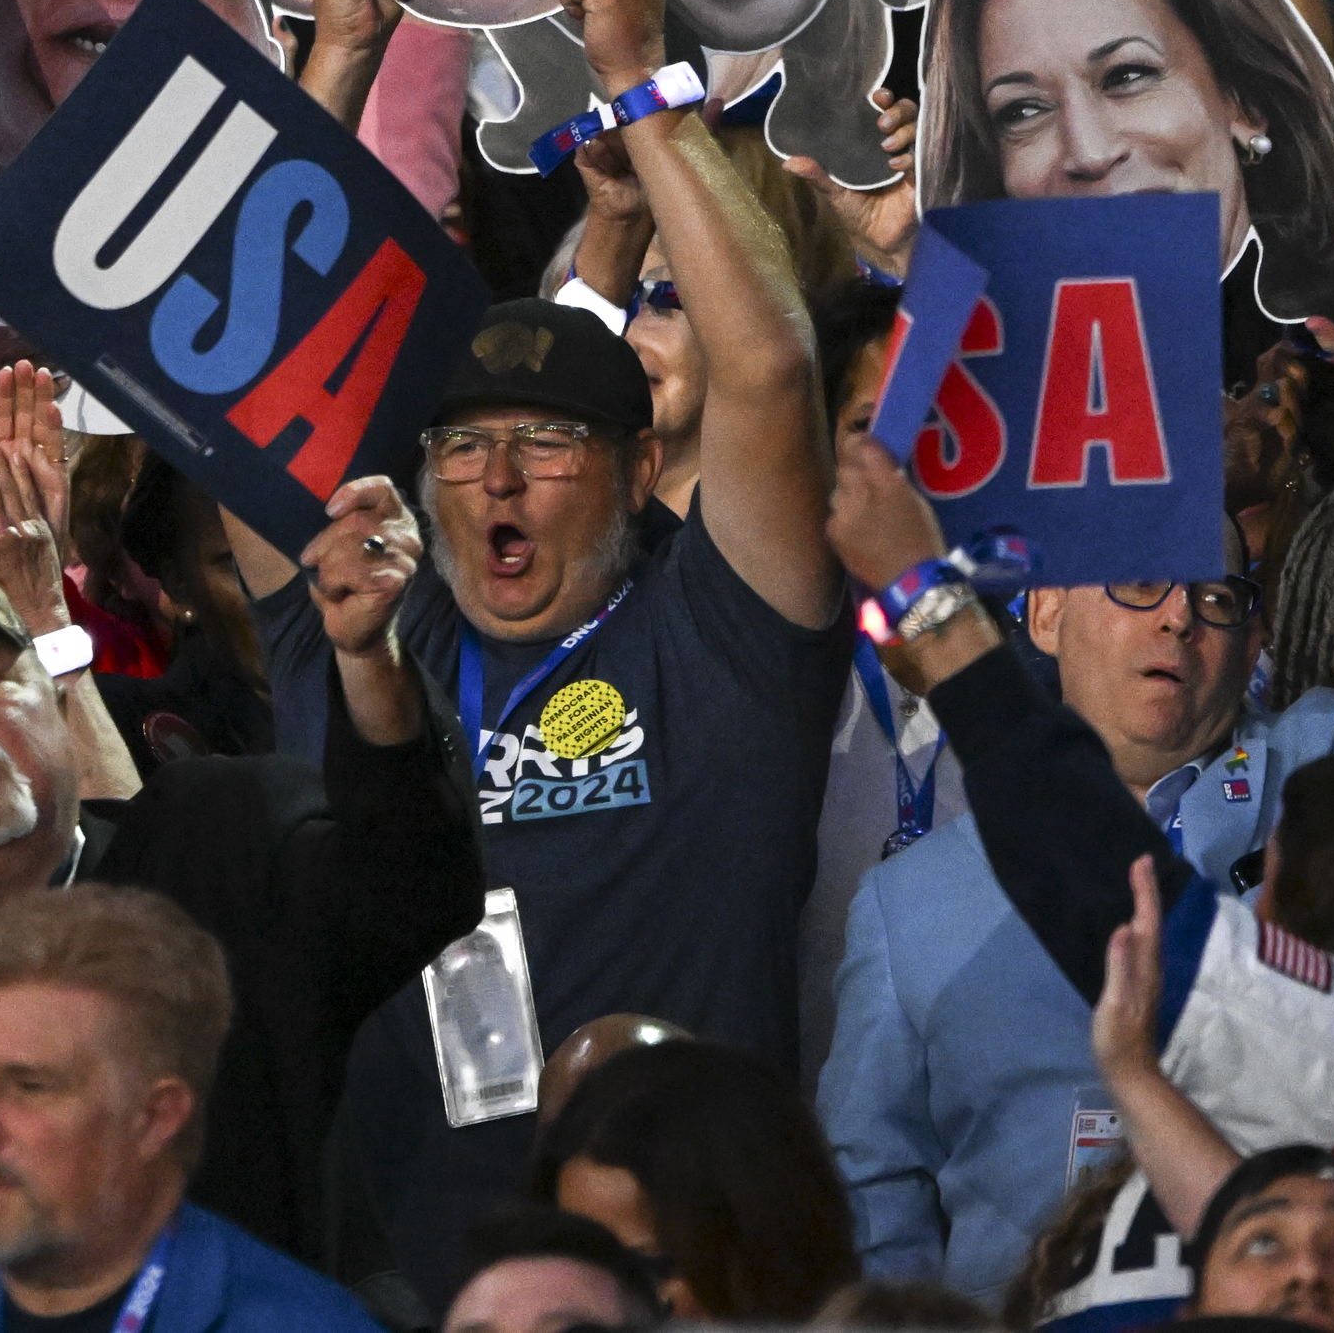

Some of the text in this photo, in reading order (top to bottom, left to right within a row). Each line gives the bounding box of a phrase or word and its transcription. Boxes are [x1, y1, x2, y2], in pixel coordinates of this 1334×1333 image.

[53, 54, 427, 503] USA
[911, 276, 1172, 499] SA
[543, 682, 601, 727] DEMOCRATS
[556, 699, 613, 744] PALESTINIAN
[568, 704, 588, 721] FOR
[574, 716, 609, 744] RIGHTS
[516, 766, 644, 814] 2024
